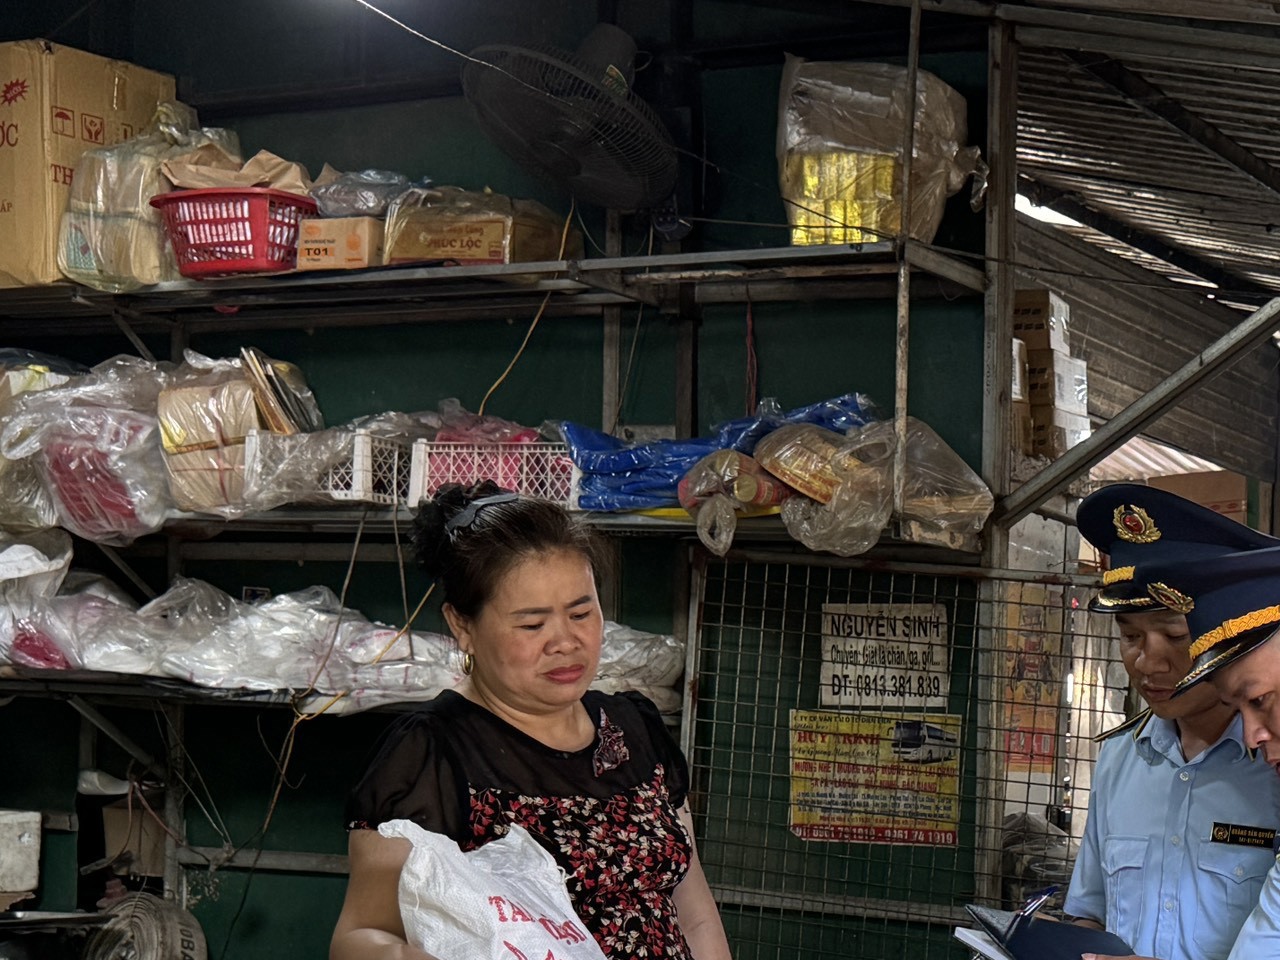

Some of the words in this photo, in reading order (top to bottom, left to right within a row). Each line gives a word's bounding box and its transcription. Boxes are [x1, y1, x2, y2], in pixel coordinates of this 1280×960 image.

[305, 247, 329, 256] T01
[831, 611, 897, 637] NGUYỄN
[902, 616, 940, 637] SINH
[857, 675, 940, 697] 0813.381.839
